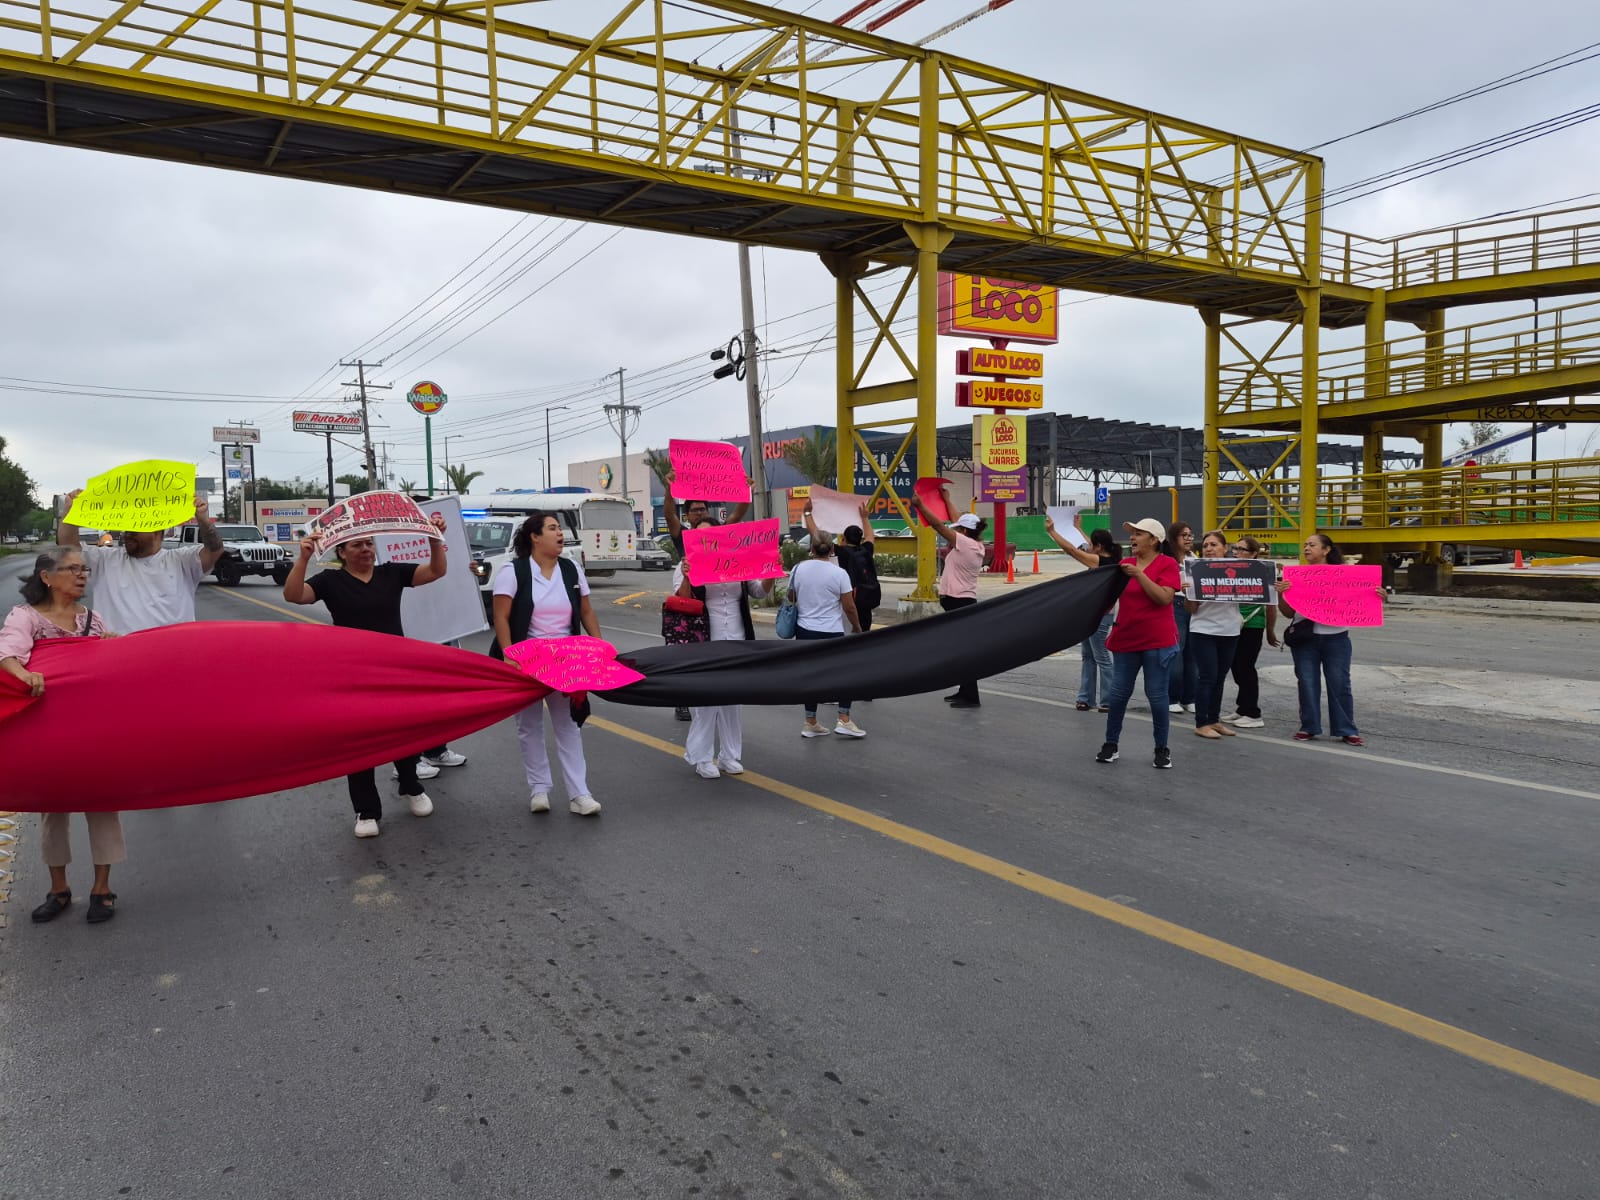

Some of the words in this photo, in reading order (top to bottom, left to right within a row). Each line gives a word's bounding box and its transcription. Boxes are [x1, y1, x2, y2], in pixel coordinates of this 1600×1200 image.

[971, 287, 1042, 323] LOCO
[975, 353, 1008, 368] AUTO
[1009, 356, 1041, 371] LOCO
[408, 392, 448, 404] Waldo's
[984, 387, 1032, 403] JUEGOS
[311, 413, 360, 424] AutoZone
[989, 448, 1019, 456] SUCURSAL
[988, 456, 1020, 465] LINARES
[134, 497, 159, 509] QUE
[386, 538, 426, 553] FALTAN
[1200, 578, 1215, 586] SIN
[1216, 578, 1263, 586] MEDICINAS
[1236, 586, 1264, 594] SALUD
